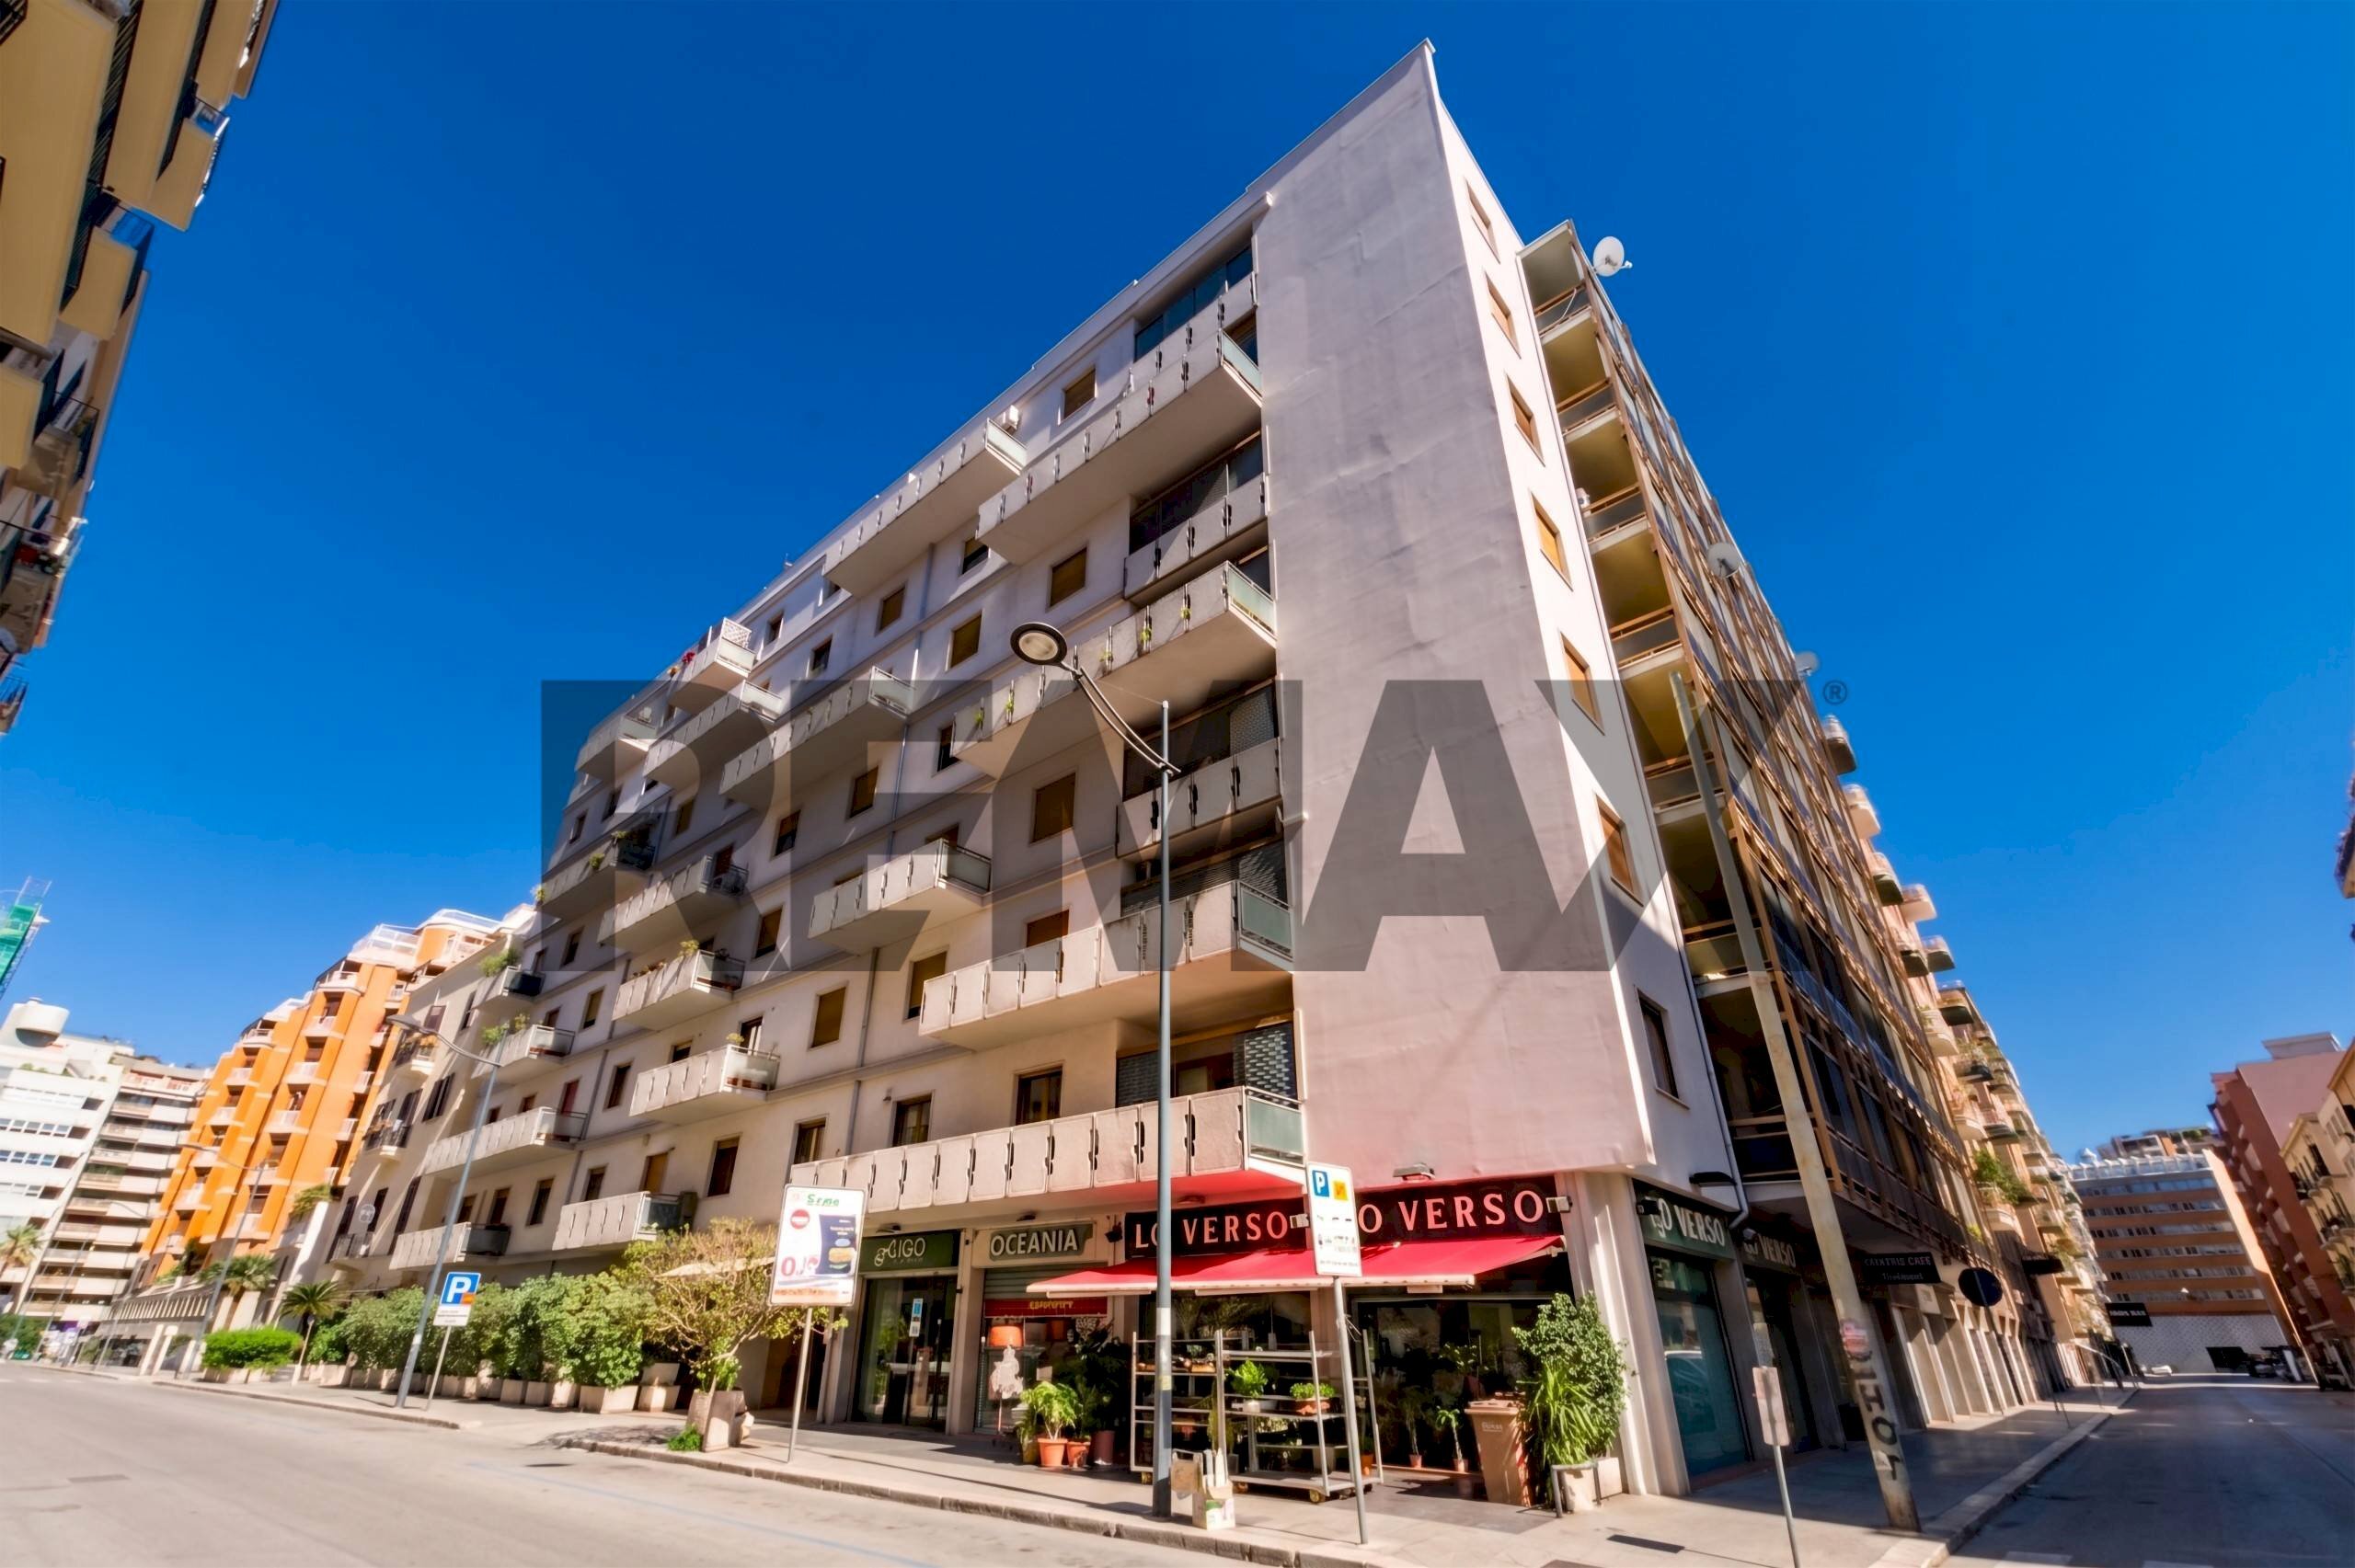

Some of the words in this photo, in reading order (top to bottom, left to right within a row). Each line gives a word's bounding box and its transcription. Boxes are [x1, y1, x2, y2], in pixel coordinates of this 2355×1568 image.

[1182, 1211, 1289, 1245] VERSO
[1397, 1190, 1544, 1231] VERSO
[1673, 1205, 1725, 1247] VERSO
[990, 1229, 1078, 1257] OCEANIA
